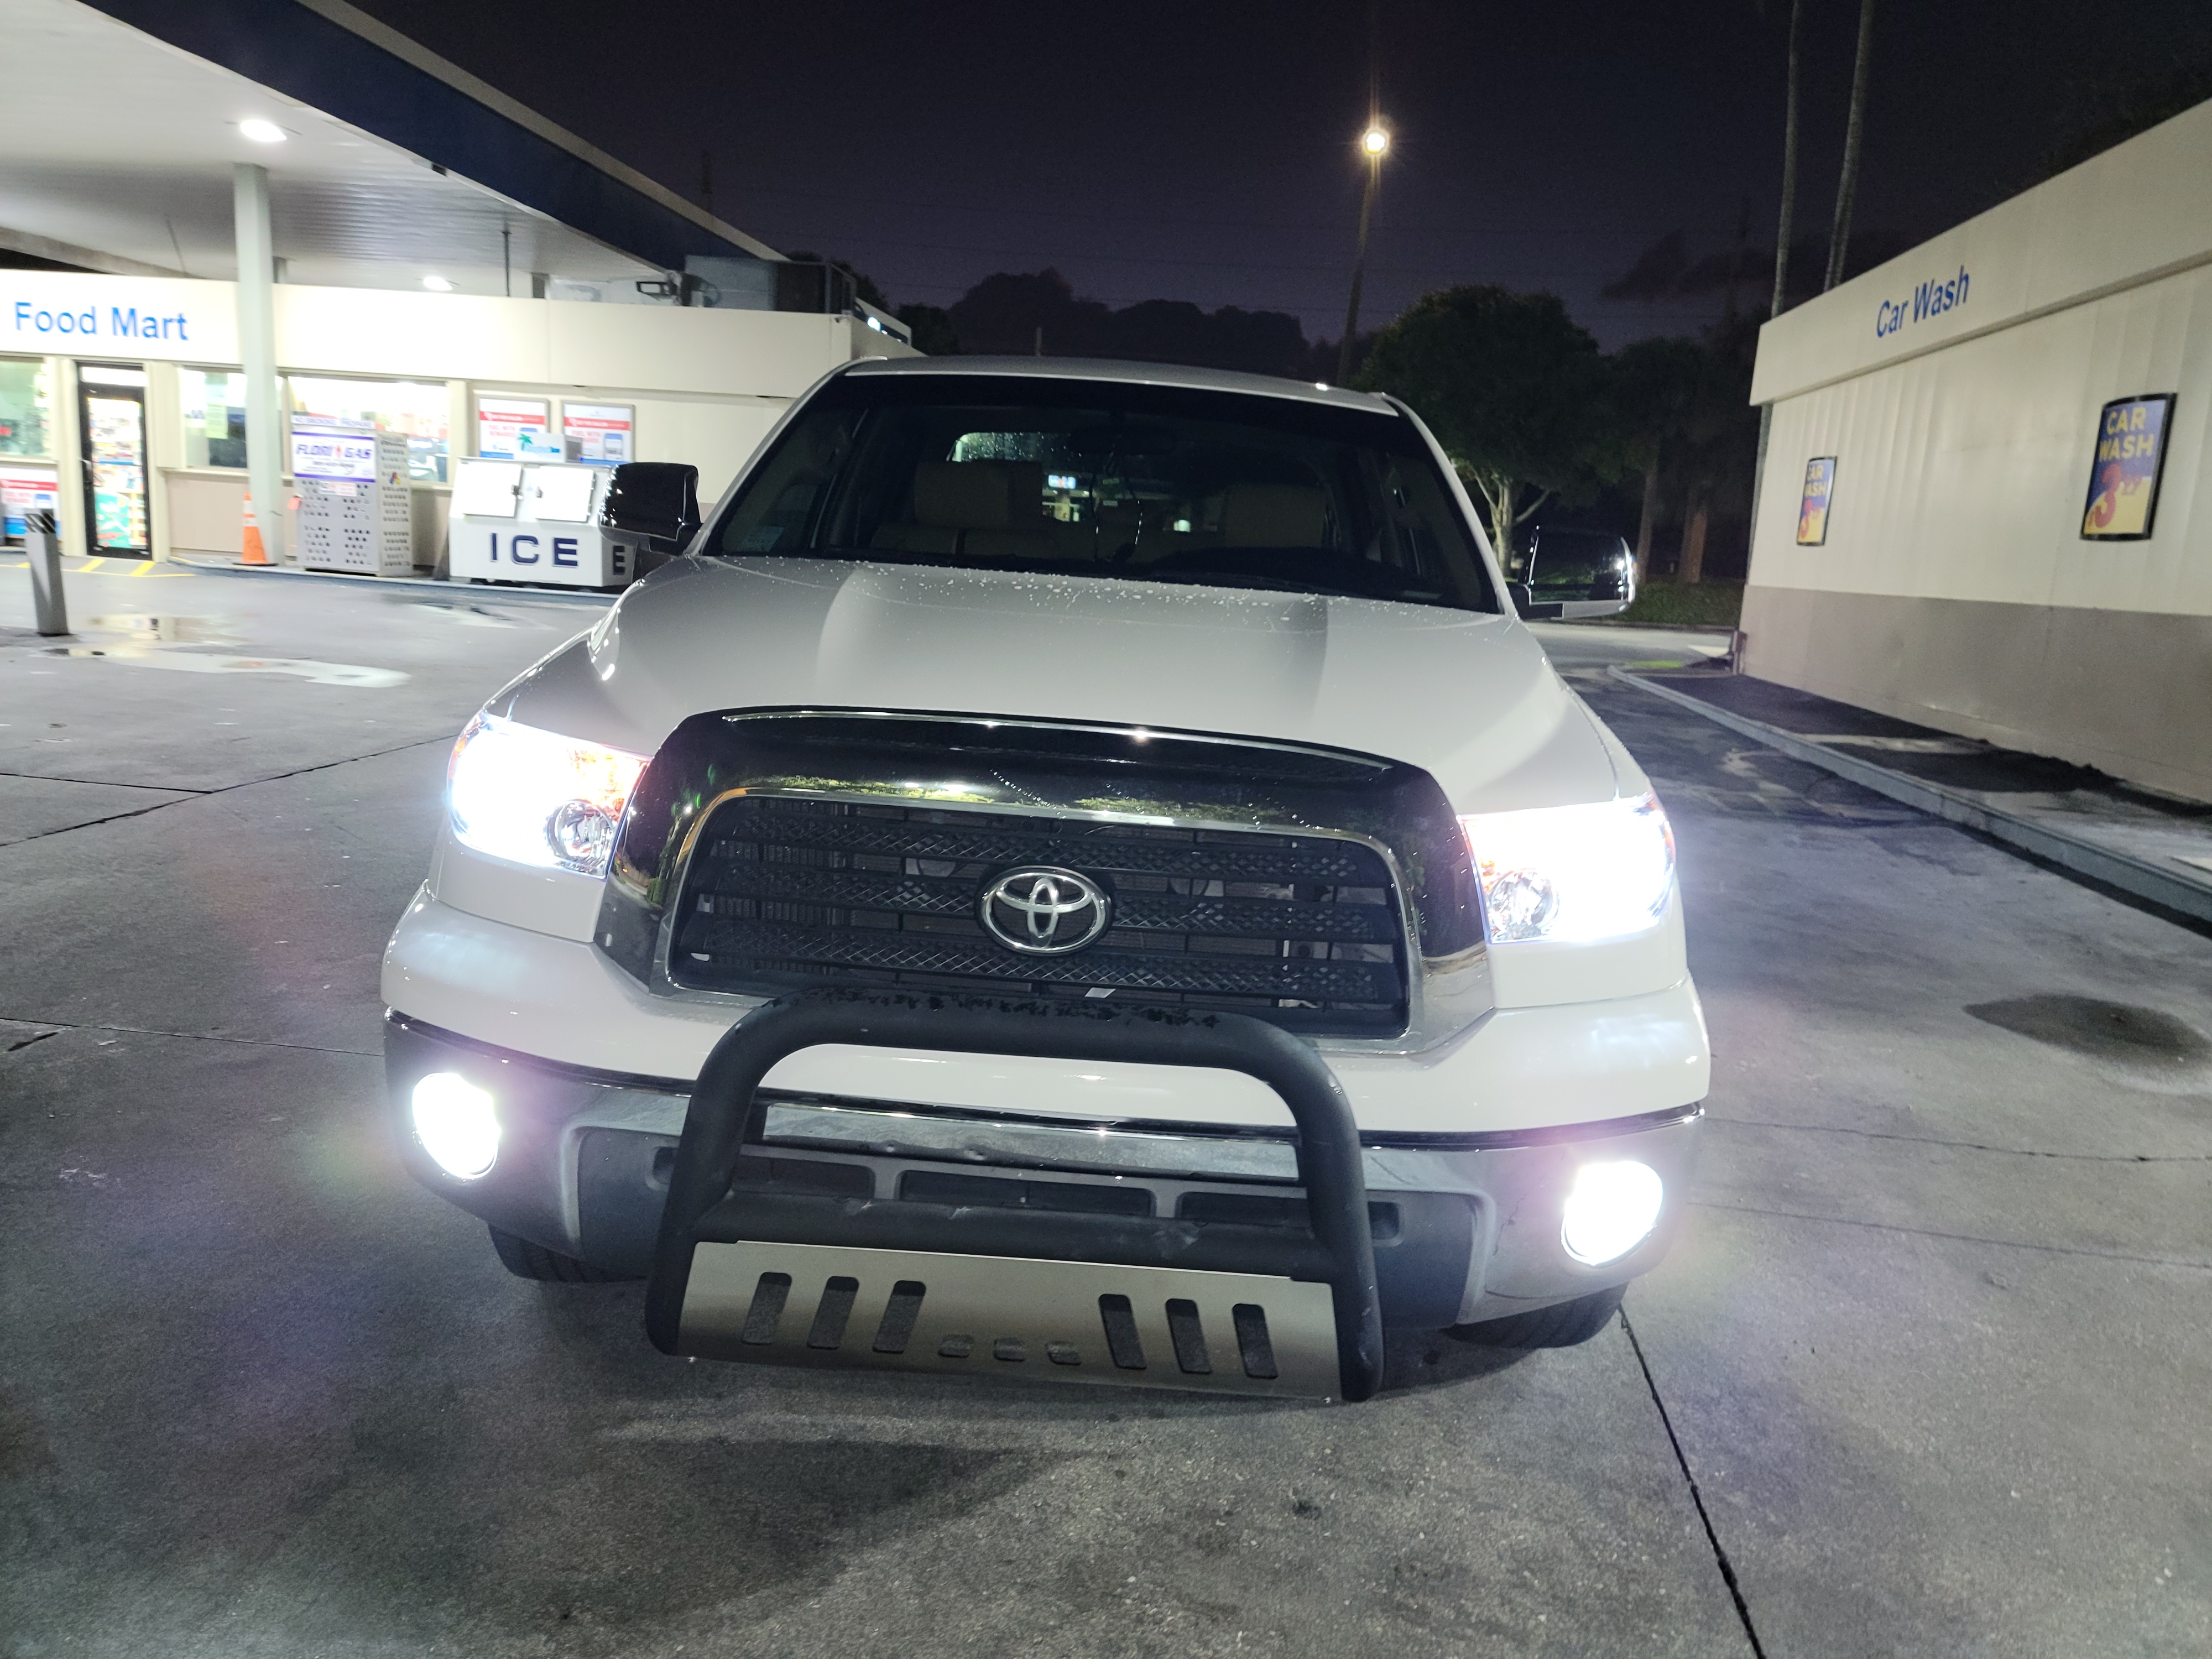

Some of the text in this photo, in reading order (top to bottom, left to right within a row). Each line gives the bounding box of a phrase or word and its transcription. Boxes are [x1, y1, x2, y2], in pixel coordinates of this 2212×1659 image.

[1877, 265, 1969, 338] Car Wash
[14, 301, 190, 341] Food Mart
[2107, 406, 2146, 435] CAR
[296, 444, 332, 457] FLORI
[344, 447, 373, 460] GAS
[2099, 434, 2154, 461] WASH
[490, 533, 579, 567] ICE
